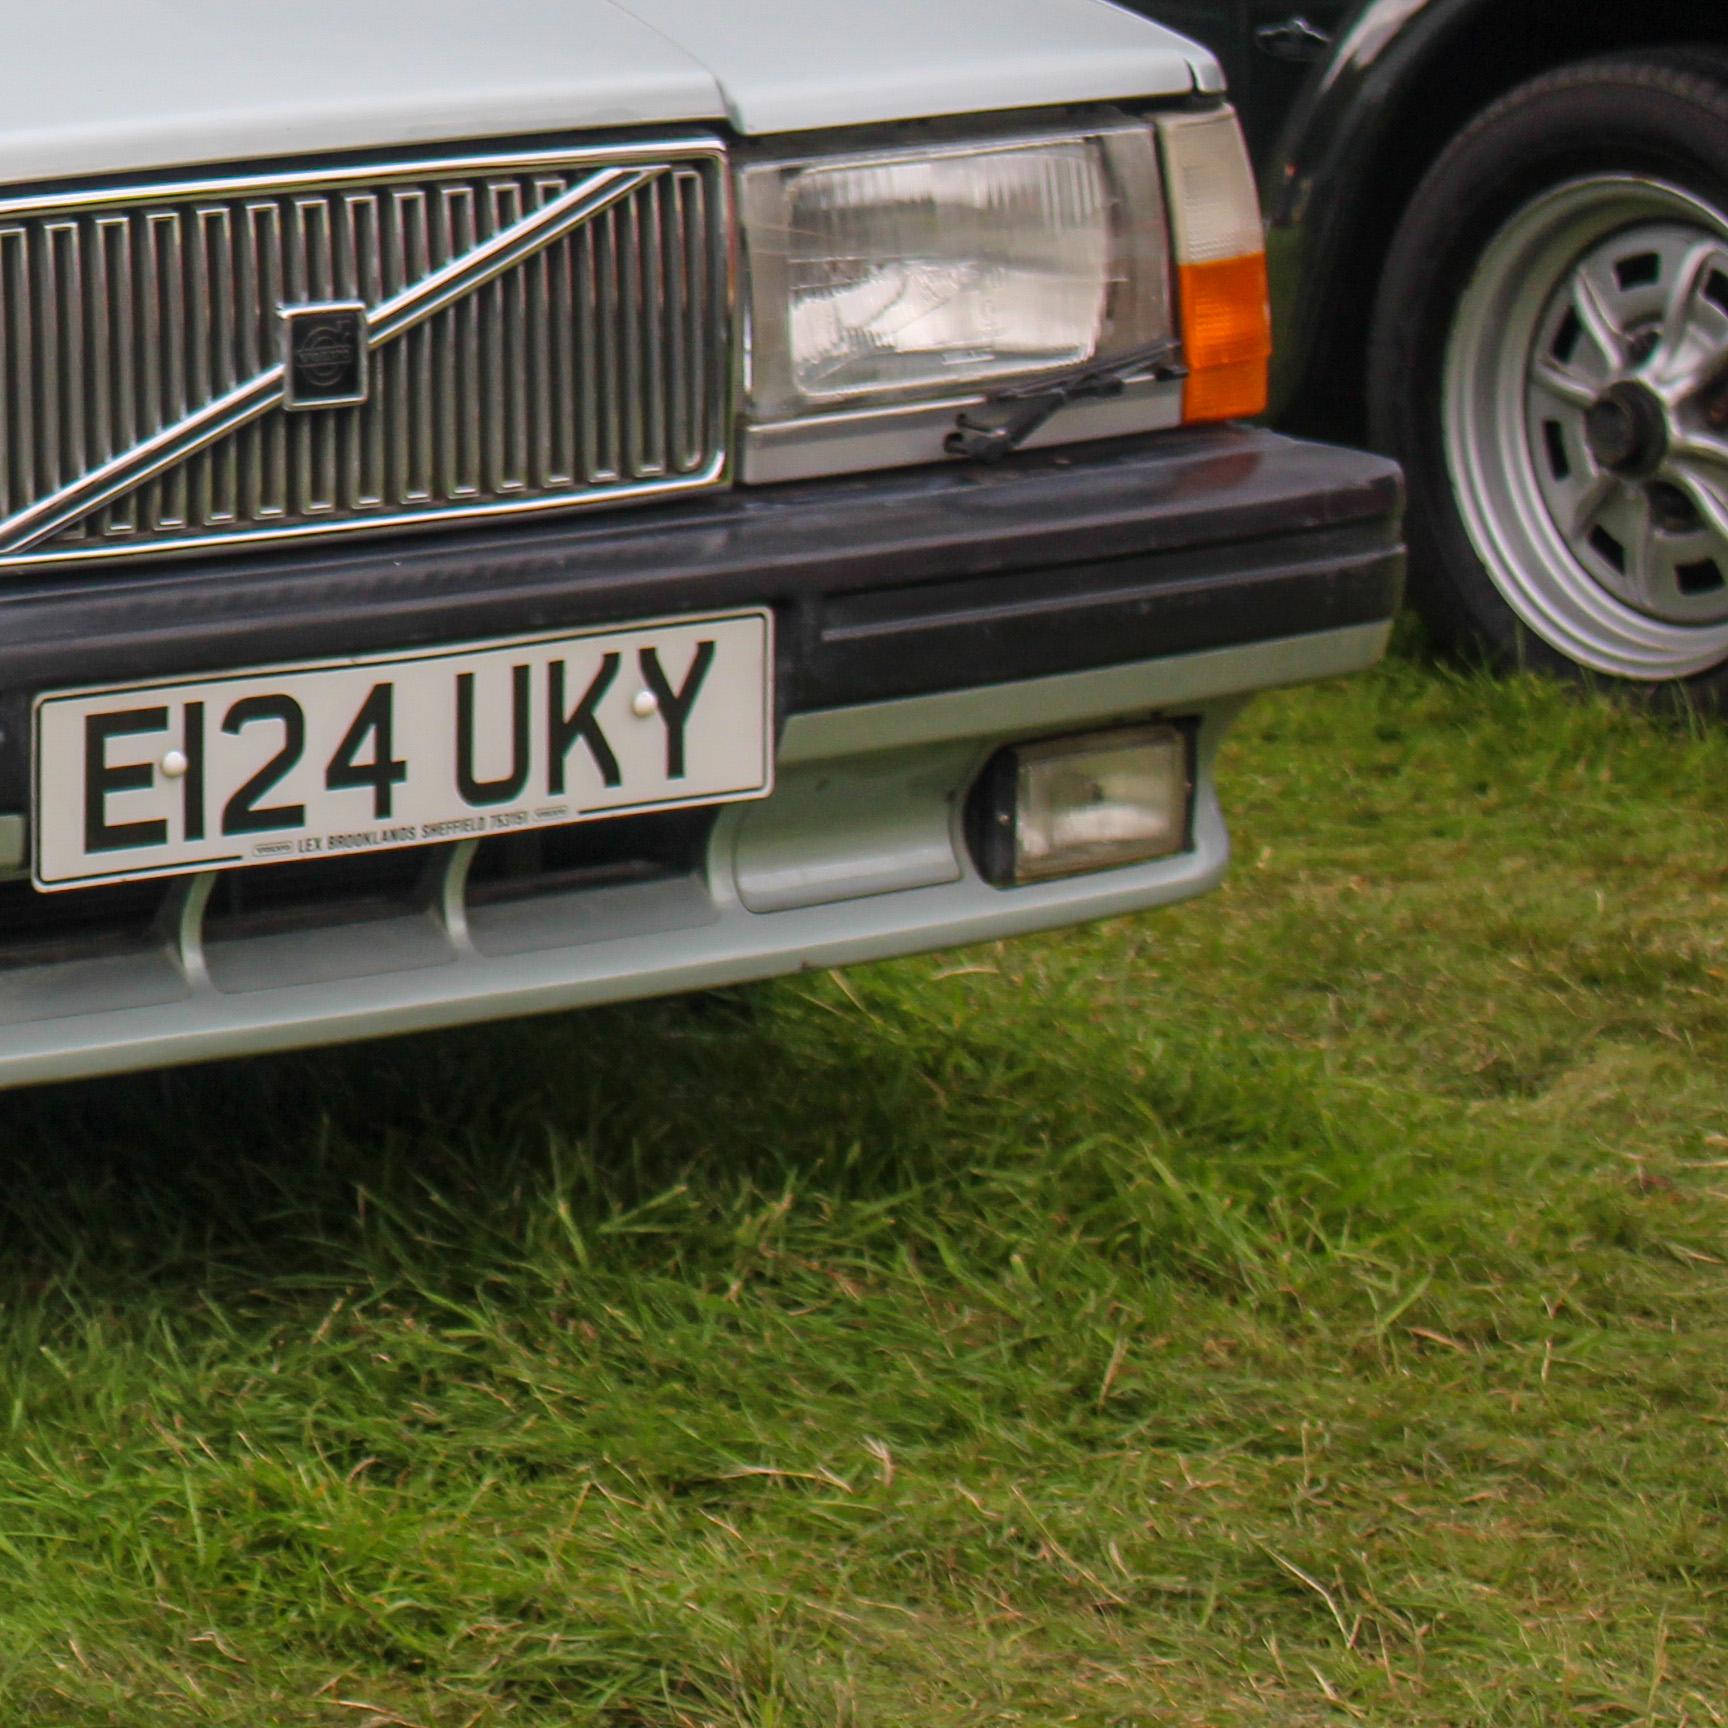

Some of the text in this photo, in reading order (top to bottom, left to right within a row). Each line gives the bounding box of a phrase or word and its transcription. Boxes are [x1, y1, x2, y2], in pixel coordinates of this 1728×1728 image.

[83, 639, 717, 857] E124 UKY
[297, 837, 323, 854] LEX
[327, 826, 416, 851] BROOKLANDS
[421, 816, 486, 839] SHEFFIELD
